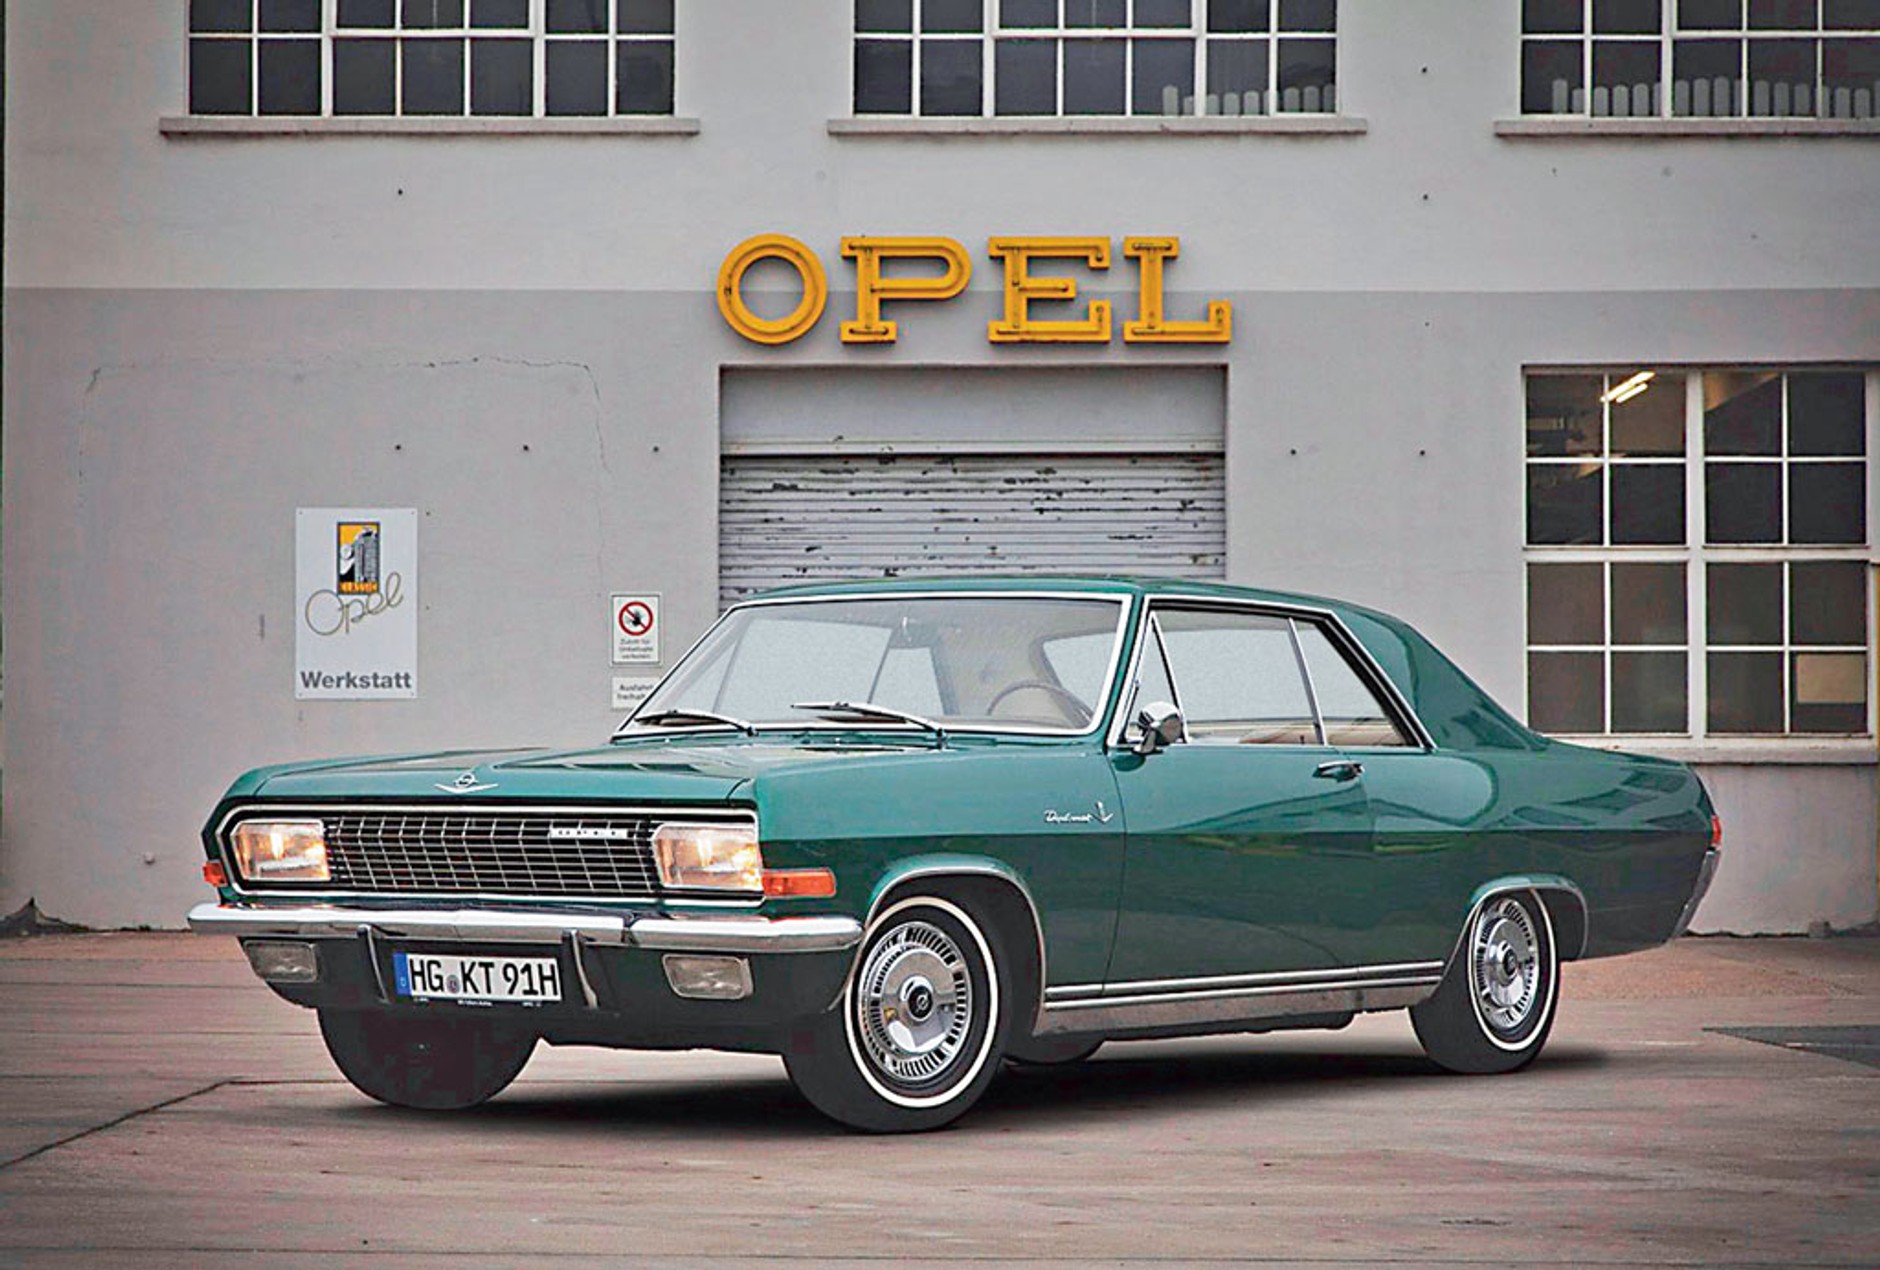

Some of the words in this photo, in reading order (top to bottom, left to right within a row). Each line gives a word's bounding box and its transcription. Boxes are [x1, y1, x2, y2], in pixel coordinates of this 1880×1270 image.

[716, 233, 1231, 346] OPEL
[305, 571, 404, 636] Opel
[300, 670, 412, 689] Werkstatt
[409, 958, 445, 993] HG
[460, 961, 495, 995] KT
[502, 962, 559, 997] 91H
